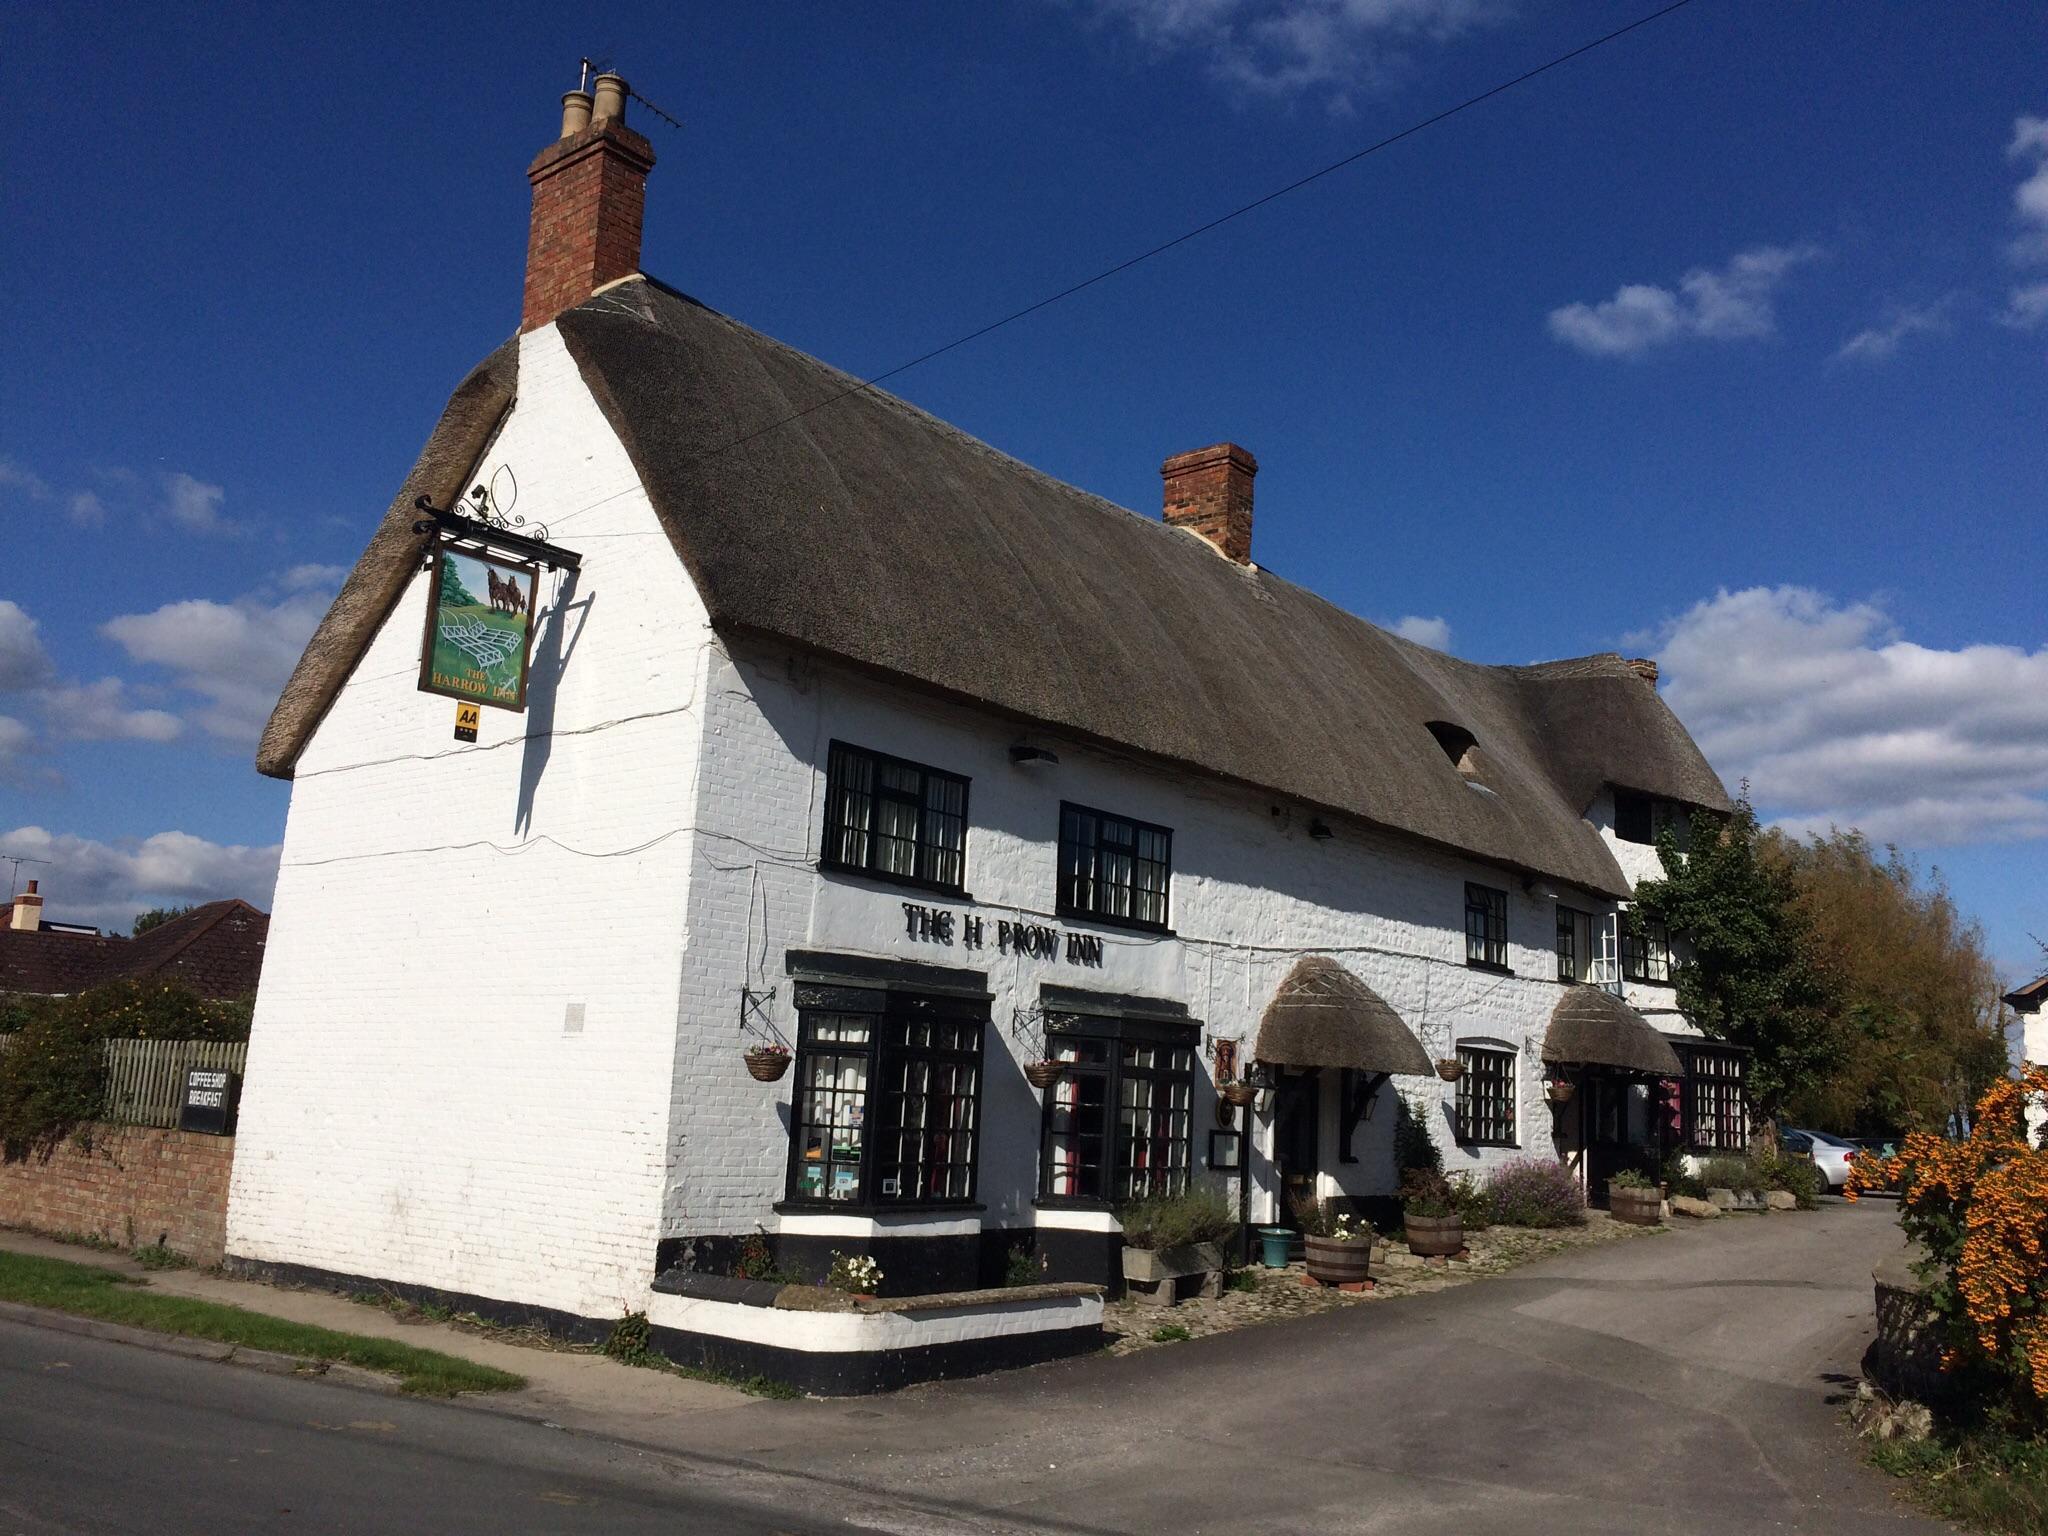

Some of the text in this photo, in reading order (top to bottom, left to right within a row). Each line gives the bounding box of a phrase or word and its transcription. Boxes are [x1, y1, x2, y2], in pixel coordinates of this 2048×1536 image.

[432, 672, 488, 693] HARROW
[466, 668, 487, 680] THE
[459, 710, 478, 725] AA
[902, 902, 952, 941] THE
[1065, 932, 1102, 963] INN
[189, 1071, 227, 1088] COFFEE SHOP
[188, 1090, 222, 1107] BREAKFAST
